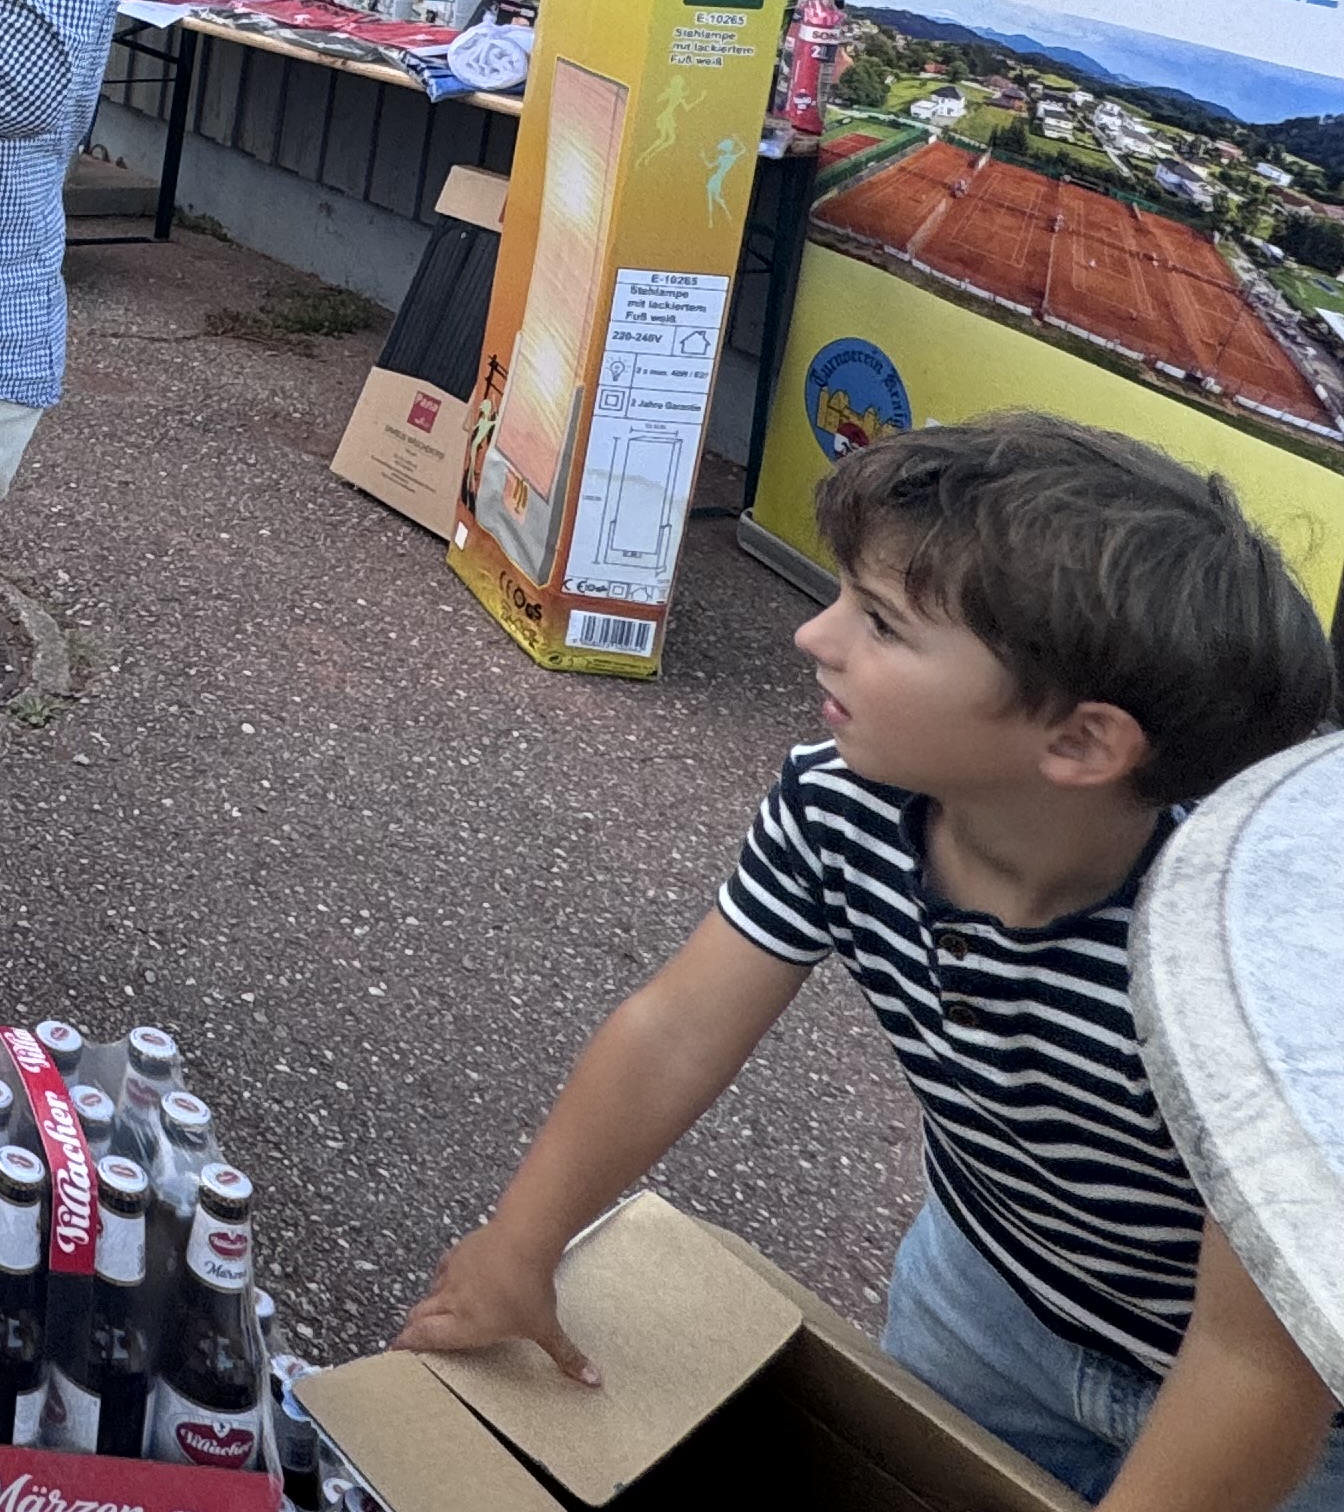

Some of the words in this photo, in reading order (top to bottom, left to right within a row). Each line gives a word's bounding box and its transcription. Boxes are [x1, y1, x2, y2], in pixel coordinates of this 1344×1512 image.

[674, 28, 736, 42] Stehlampe
[651, 274, 698, 286] E-10265
[43, 1090, 92, 1254] Villacher
[179, 1428, 253, 1457] Villacher
